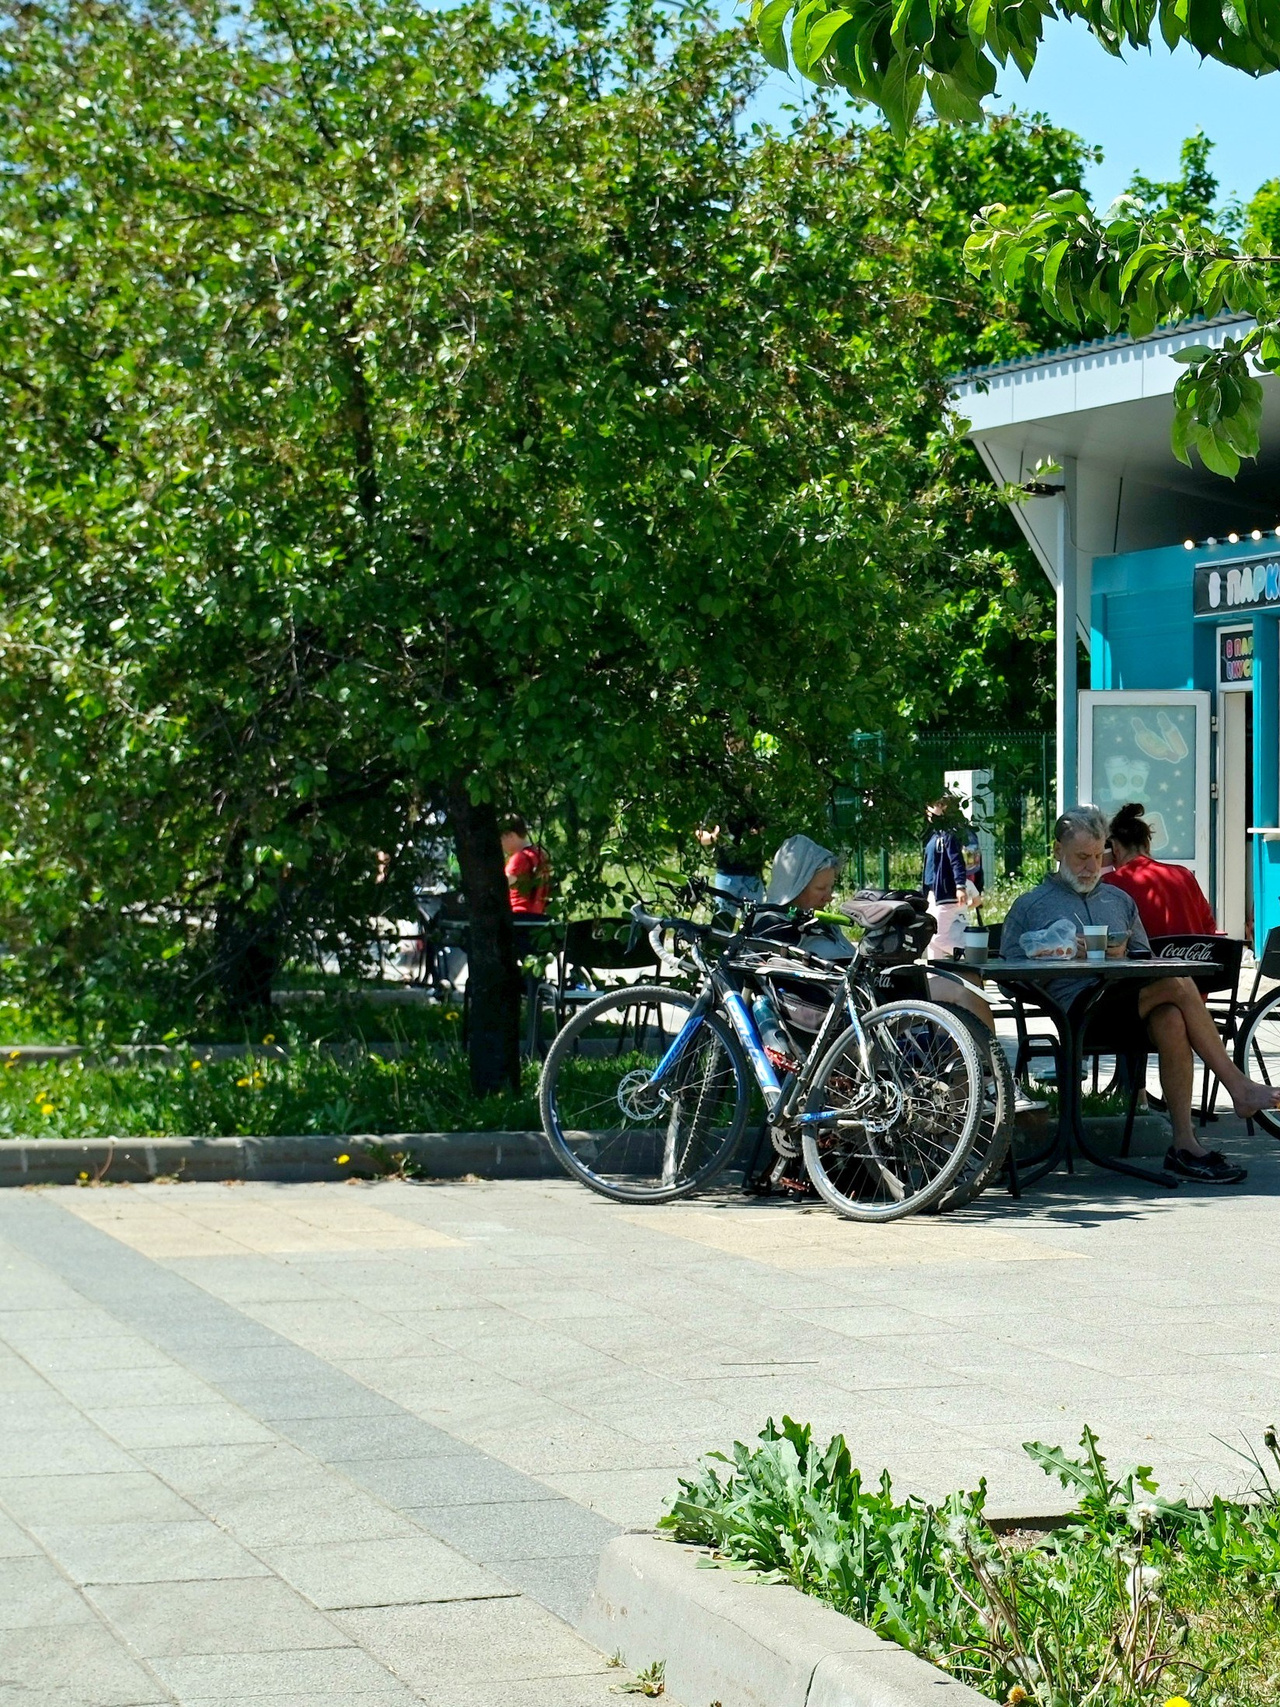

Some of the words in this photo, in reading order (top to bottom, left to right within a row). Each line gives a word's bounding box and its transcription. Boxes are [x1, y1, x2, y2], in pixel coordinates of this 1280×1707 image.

[1208, 571, 1221, 608] В
[1226, 639, 1233, 658] В
[1234, 636, 1253, 657] ПАР
[1160, 942, 1215, 960] Coca-Cola
